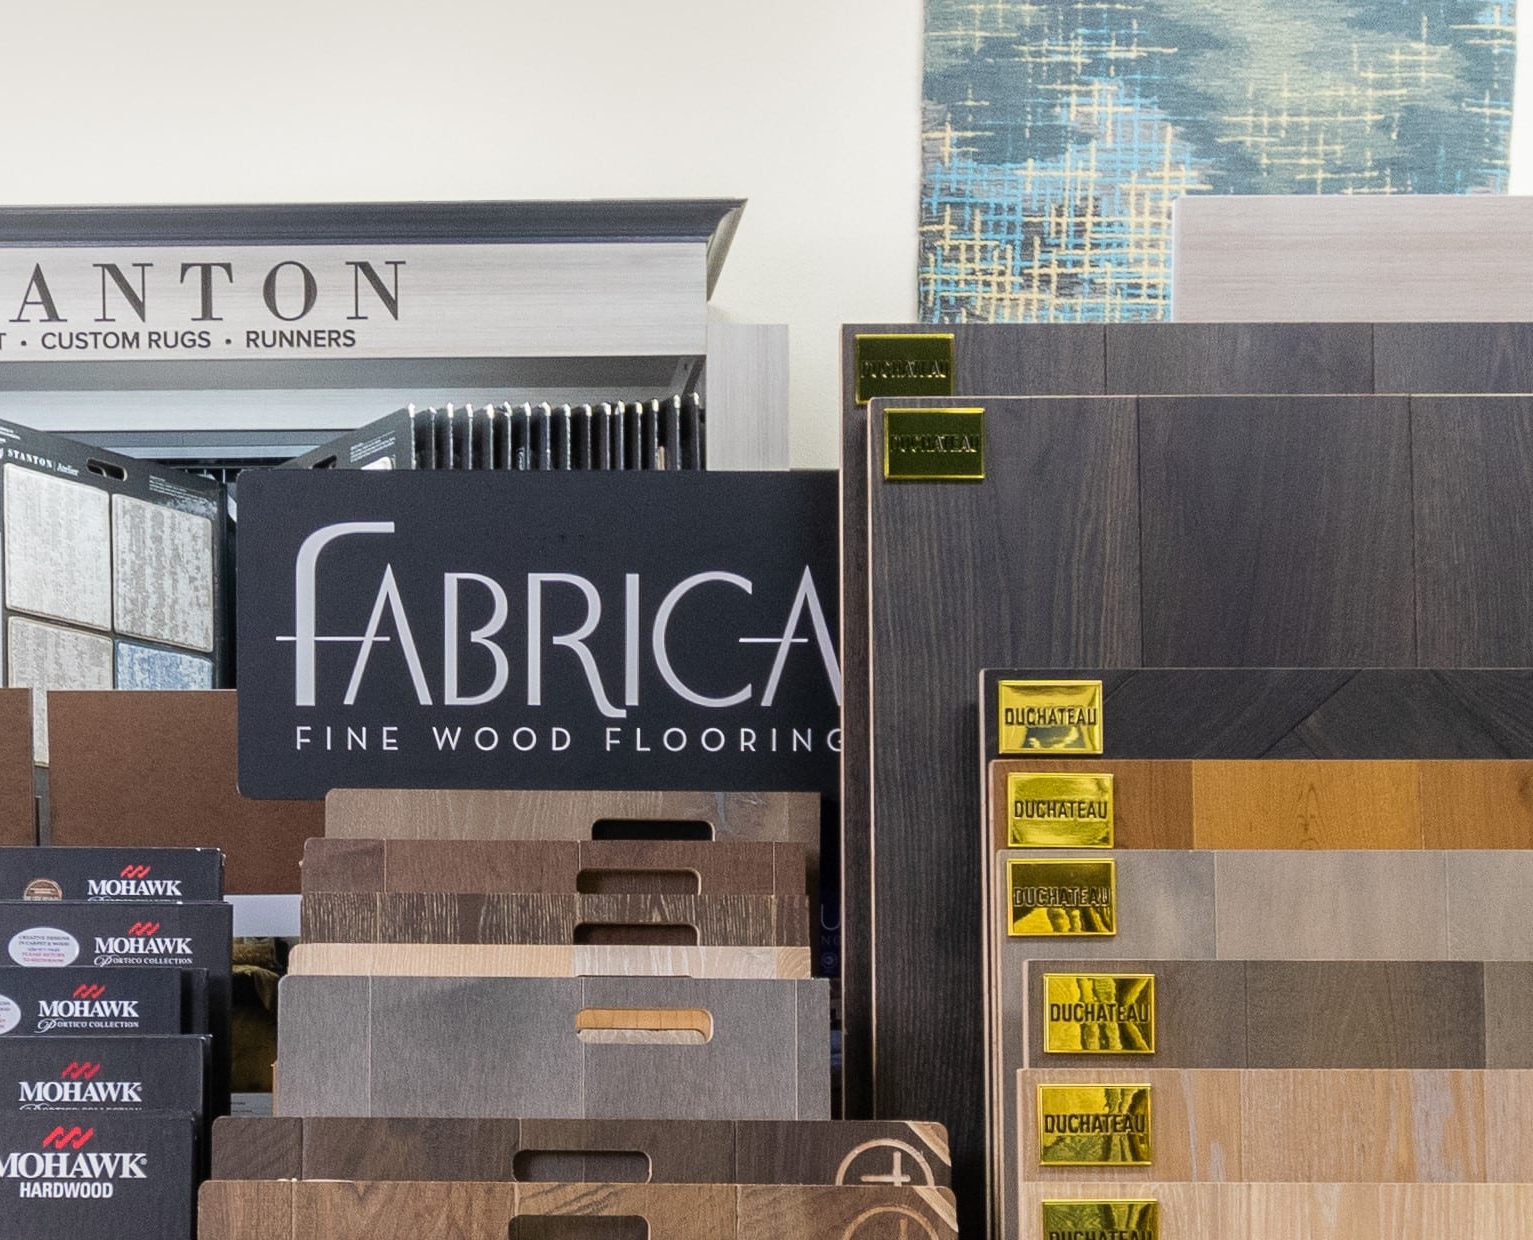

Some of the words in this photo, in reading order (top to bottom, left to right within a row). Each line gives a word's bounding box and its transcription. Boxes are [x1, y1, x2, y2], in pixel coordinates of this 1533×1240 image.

[40, 331, 141, 351] CUSTOM
[147, 330, 211, 351] RUGS
[245, 329, 356, 349] RUNNERS
[7, 448, 53, 469] STANTON
[276, 521, 841, 718] FABRICA
[1005, 707, 1097, 726] DUCHATEAU
[296, 726, 400, 752] FINE
[433, 726, 572, 752] WOOD
[1014, 800, 1107, 819] DUCHATEAU
[87, 879, 182, 896] MOHAWK
[1013, 886, 1111, 907] DUCHATEAU
[94, 937, 193, 954] MOHAWK
[93, 955, 142, 967] PORTICO
[143, 957, 193, 965] COLLECTION
[38, 1000, 139, 1018] MOHAWK
[1049, 1003, 1150, 1023] DUCHATEAU
[34, 1019, 87, 1034] PORTICO
[88, 1020, 139, 1028] COLLECTION
[18, 1081, 142, 1102] MOHAWK
[1044, 1114, 1146, 1134] DUCHATEAU
[19, 1182, 114, 1198] HARDWOOD
